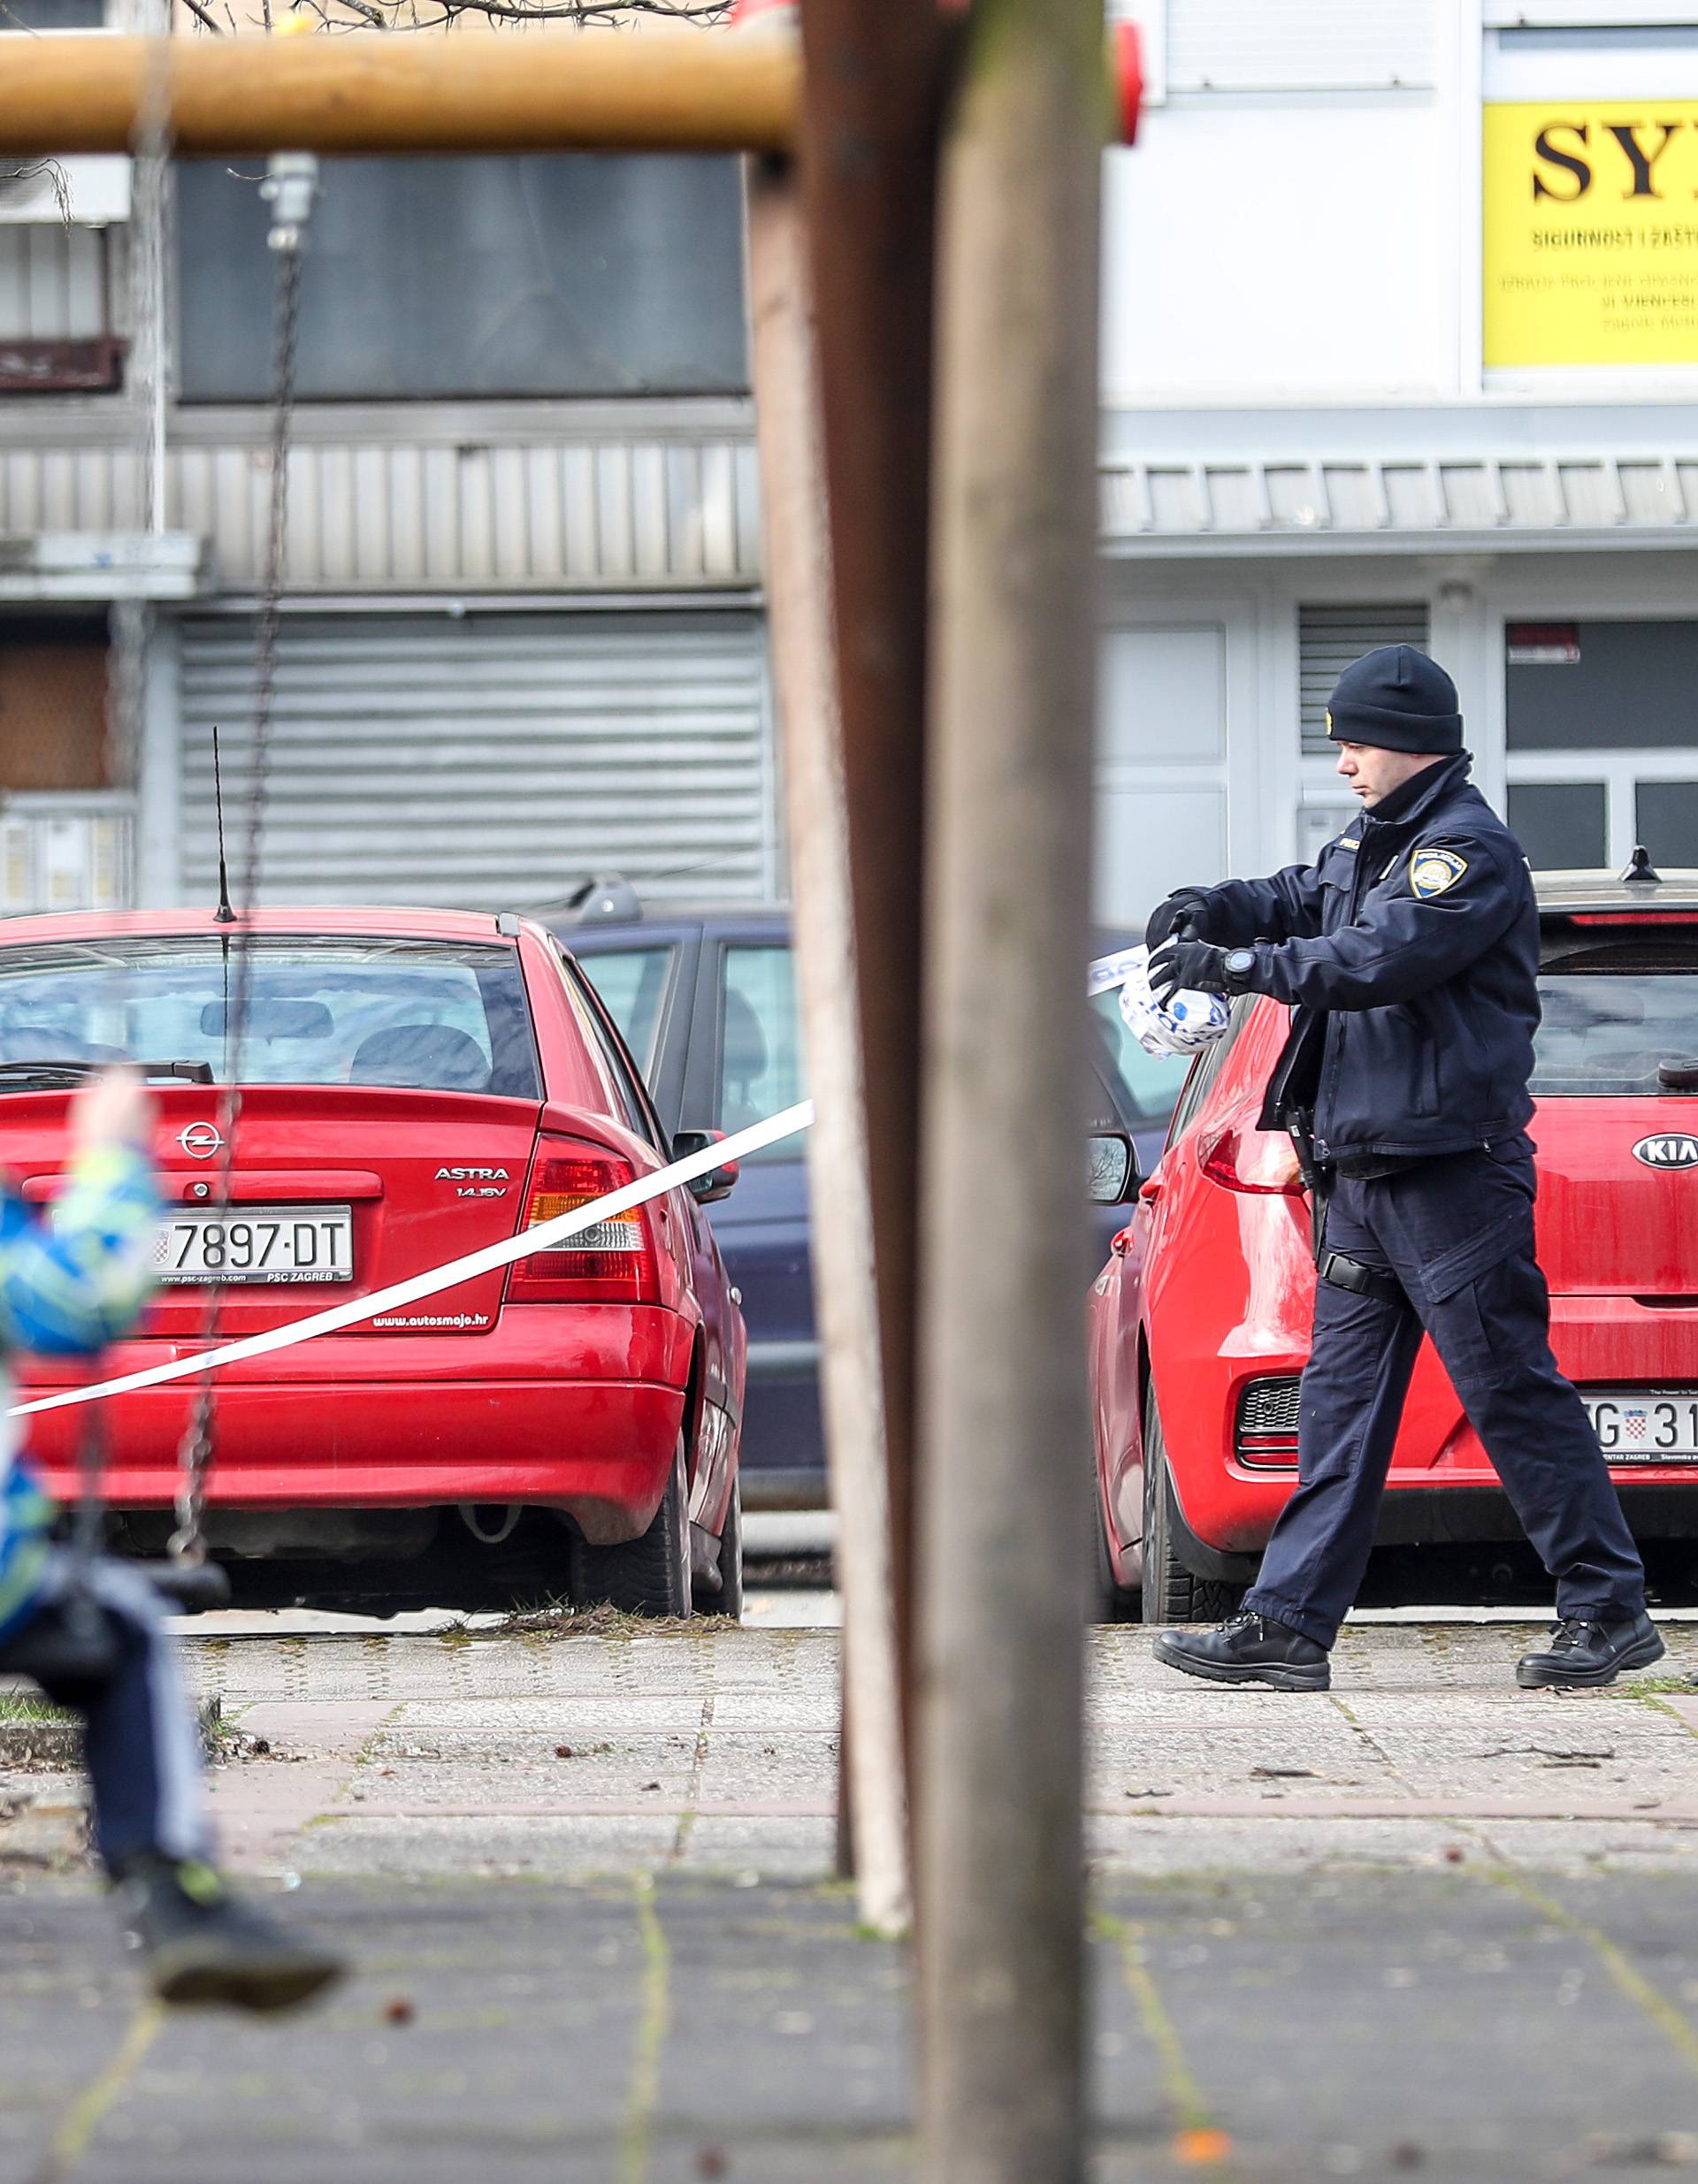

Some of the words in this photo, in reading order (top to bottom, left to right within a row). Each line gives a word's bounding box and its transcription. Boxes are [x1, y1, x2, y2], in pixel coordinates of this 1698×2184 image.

[1533, 120, 1698, 202] SY
[1648, 1141, 1698, 1161] KIA
[434, 1167, 509, 1180] ASTRA
[267, 1273, 288, 1282] PSC
[291, 1271, 333, 1282] ZAGREB
[372, 1313, 489, 1329] www.autosmojo.hr
